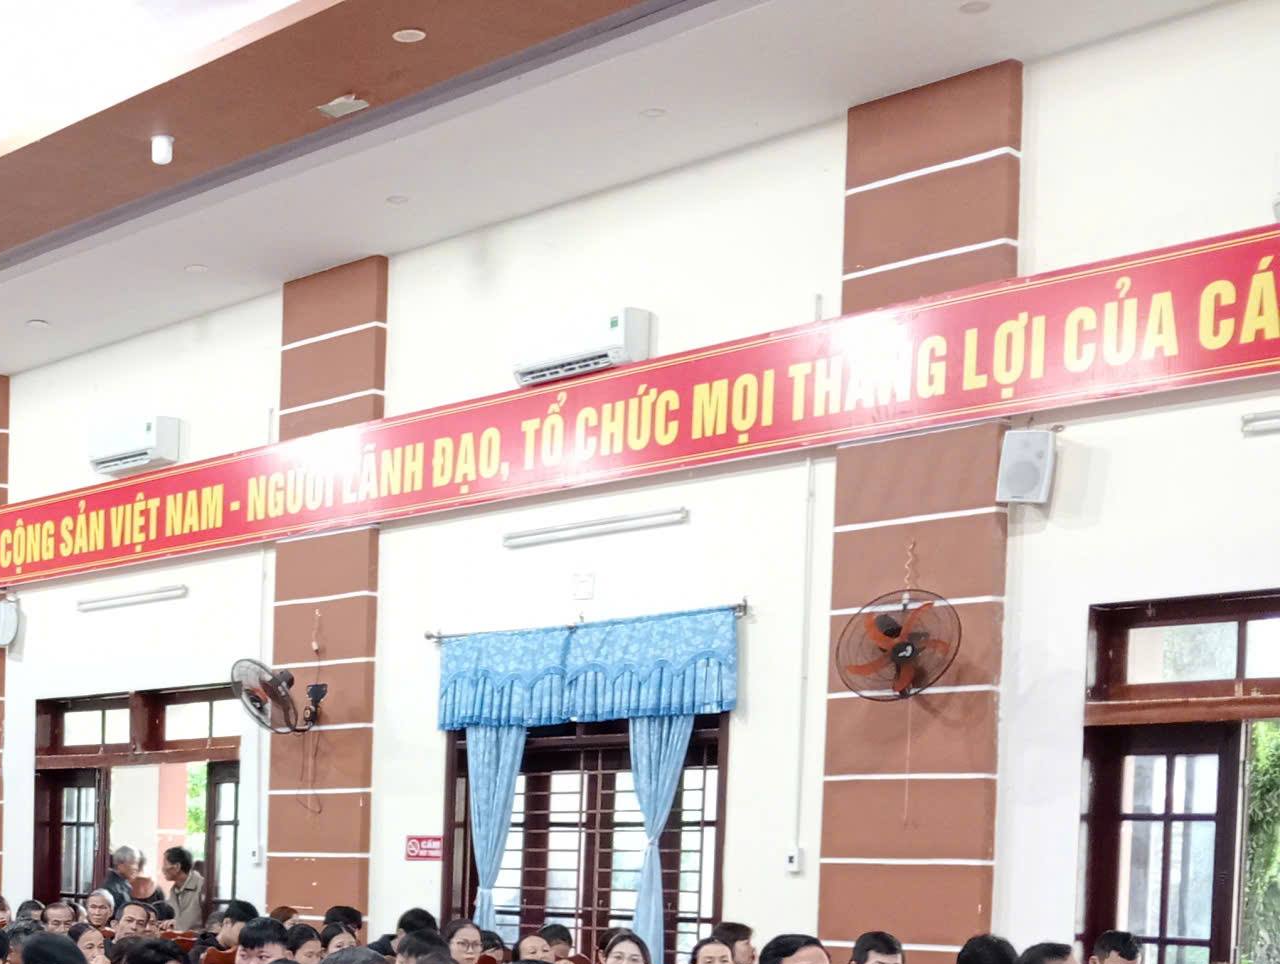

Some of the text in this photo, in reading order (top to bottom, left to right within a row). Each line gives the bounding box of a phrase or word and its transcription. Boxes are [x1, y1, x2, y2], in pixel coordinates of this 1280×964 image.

[0, 518, 55, 574] CỘNG
[60, 500, 105, 557] SẢN
[110, 492, 160, 552] VIỆT
[165, 484, 224, 537] NAM
[432, 427, 510, 494] ĐẠO,
[521, 391, 567, 471] TỔ
[572, 384, 680, 463] CHỨC
[691, 369, 775, 444] MỌI
[962, 311, 1046, 399] LỢI
[1064, 276, 1179, 373] CỦA
